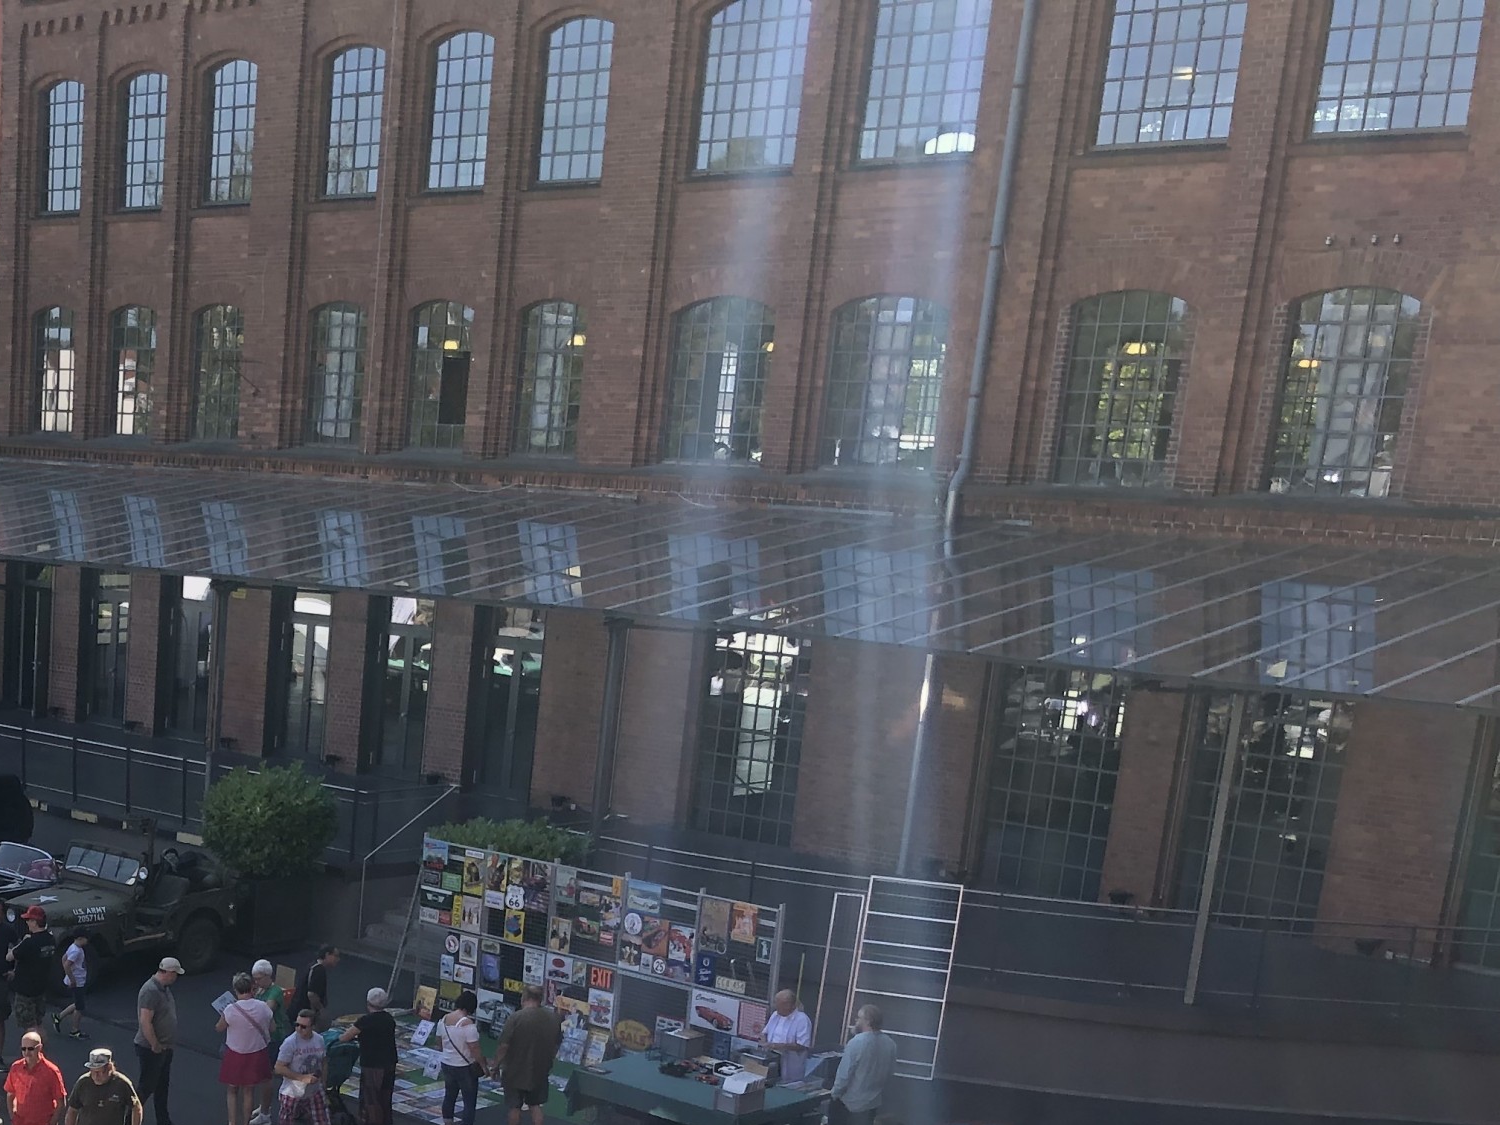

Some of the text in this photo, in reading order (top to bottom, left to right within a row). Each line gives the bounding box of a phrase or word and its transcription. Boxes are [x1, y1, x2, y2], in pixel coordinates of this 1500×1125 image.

[508, 898, 520, 908] 66
[86, 906, 106, 914] ARMY
[654, 961, 664, 972] 25
[590, 966, 613, 989] EXIT
[619, 1030, 647, 1047] SALE
